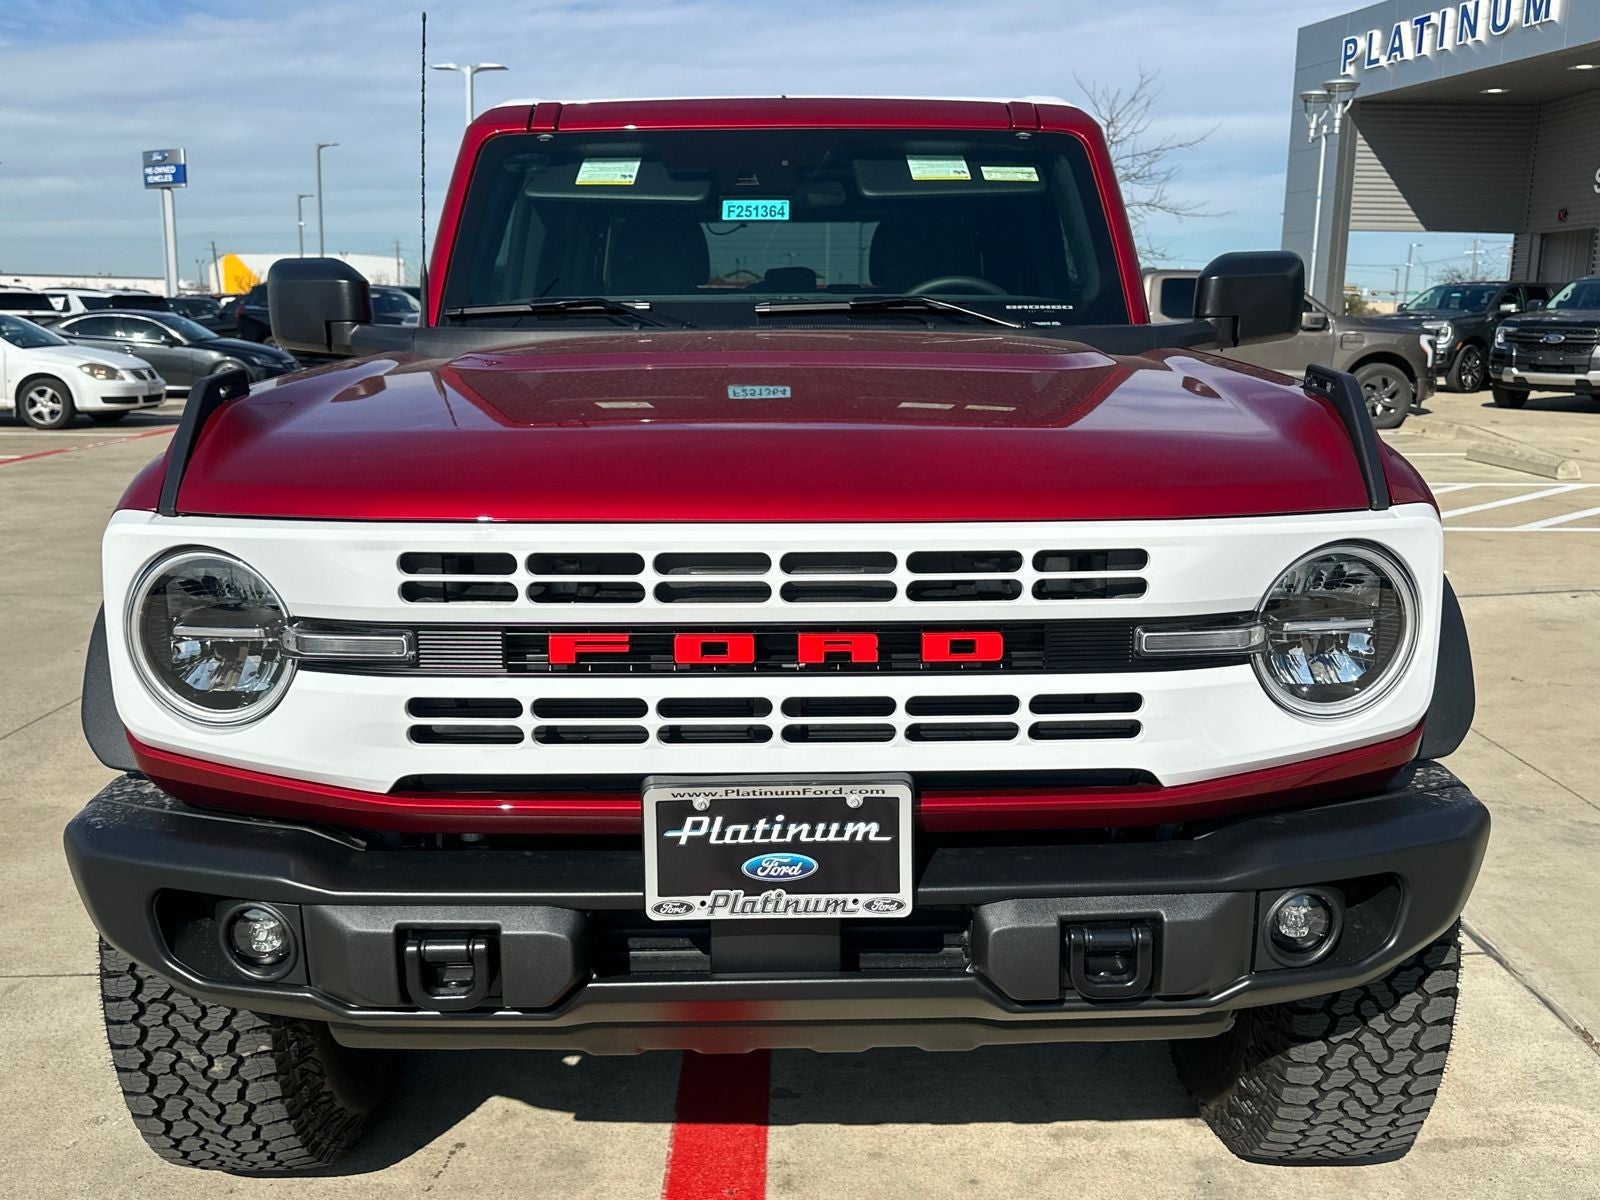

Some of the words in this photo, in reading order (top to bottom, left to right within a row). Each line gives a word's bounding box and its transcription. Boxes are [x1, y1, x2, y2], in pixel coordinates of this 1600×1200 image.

[1340, 0, 1553, 75] PLATINUM
[727, 204, 786, 218] F251364
[548, 631, 1004, 664] FORD
[671, 787, 886, 798] www.PlatinumFord.com
[663, 814, 893, 845] Platinum
[756, 857, 803, 877] Ford
[659, 902, 688, 914] Ford
[706, 890, 860, 916] Platinum
[870, 899, 899, 911] Ford
